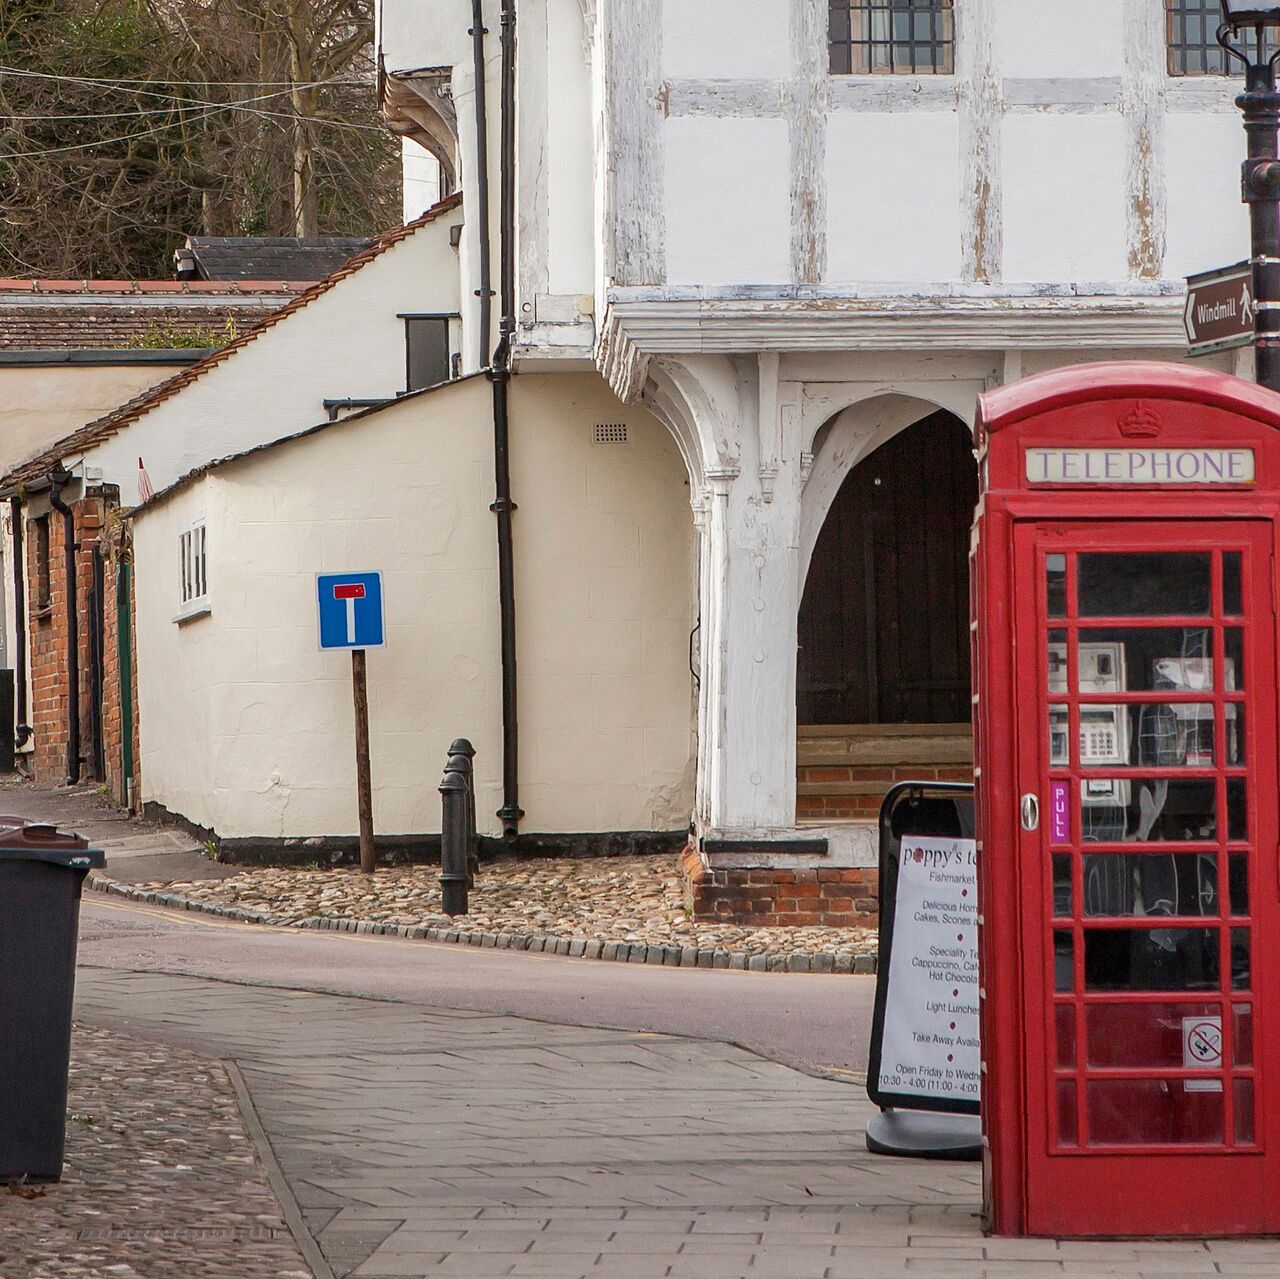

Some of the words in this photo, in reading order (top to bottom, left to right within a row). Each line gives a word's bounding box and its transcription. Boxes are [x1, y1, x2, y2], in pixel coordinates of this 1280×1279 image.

[1197, 298, 1237, 324] Windmill
[1035, 452, 1246, 479] TELEPHONE
[1055, 788, 1065, 837] PULL
[929, 871, 975, 885] Fishmarket
[922, 900, 957, 912] Delicious
[914, 912, 940, 924] Cakes,
[942, 914, 971, 926] Scones
[930, 946, 968, 960] Speciality
[912, 957, 961, 971] Cappuccino,
[929, 971, 943, 981] Hot
[926, 1001, 946, 1013] Light
[912, 1032, 931, 1043] Take
[933, 1034, 954, 1047] Away
[896, 1063, 917, 1075] Open
[920, 1066, 943, 1078] Friday
[945, 1069, 953, 1078] to
